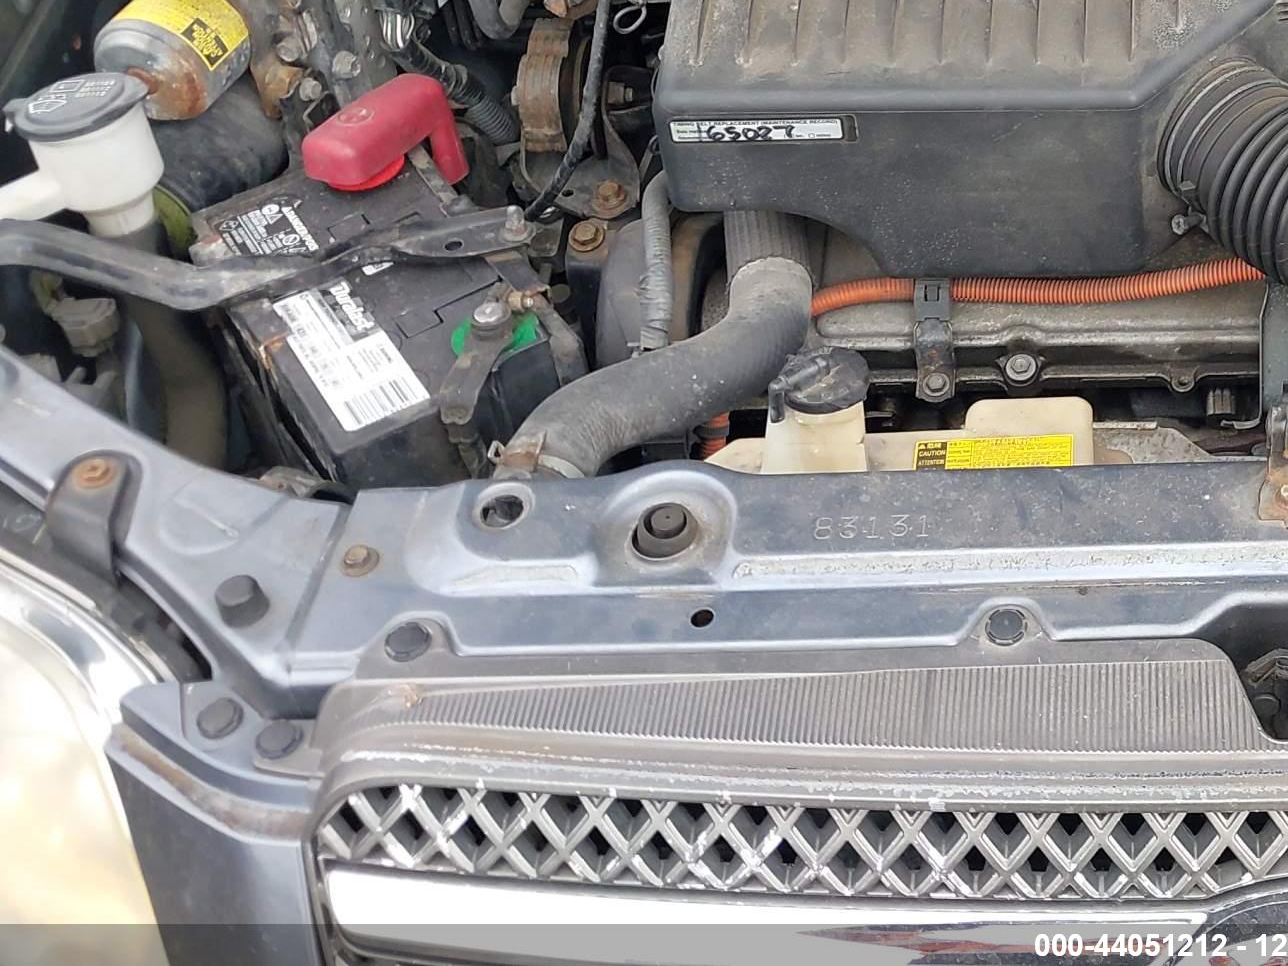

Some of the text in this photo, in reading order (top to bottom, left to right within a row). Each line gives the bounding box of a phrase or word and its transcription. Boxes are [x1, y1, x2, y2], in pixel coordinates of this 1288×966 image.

[328, 281, 376, 332] Duralast
[918, 449, 946, 457] CAUTION
[813, 514, 929, 540] 83131
